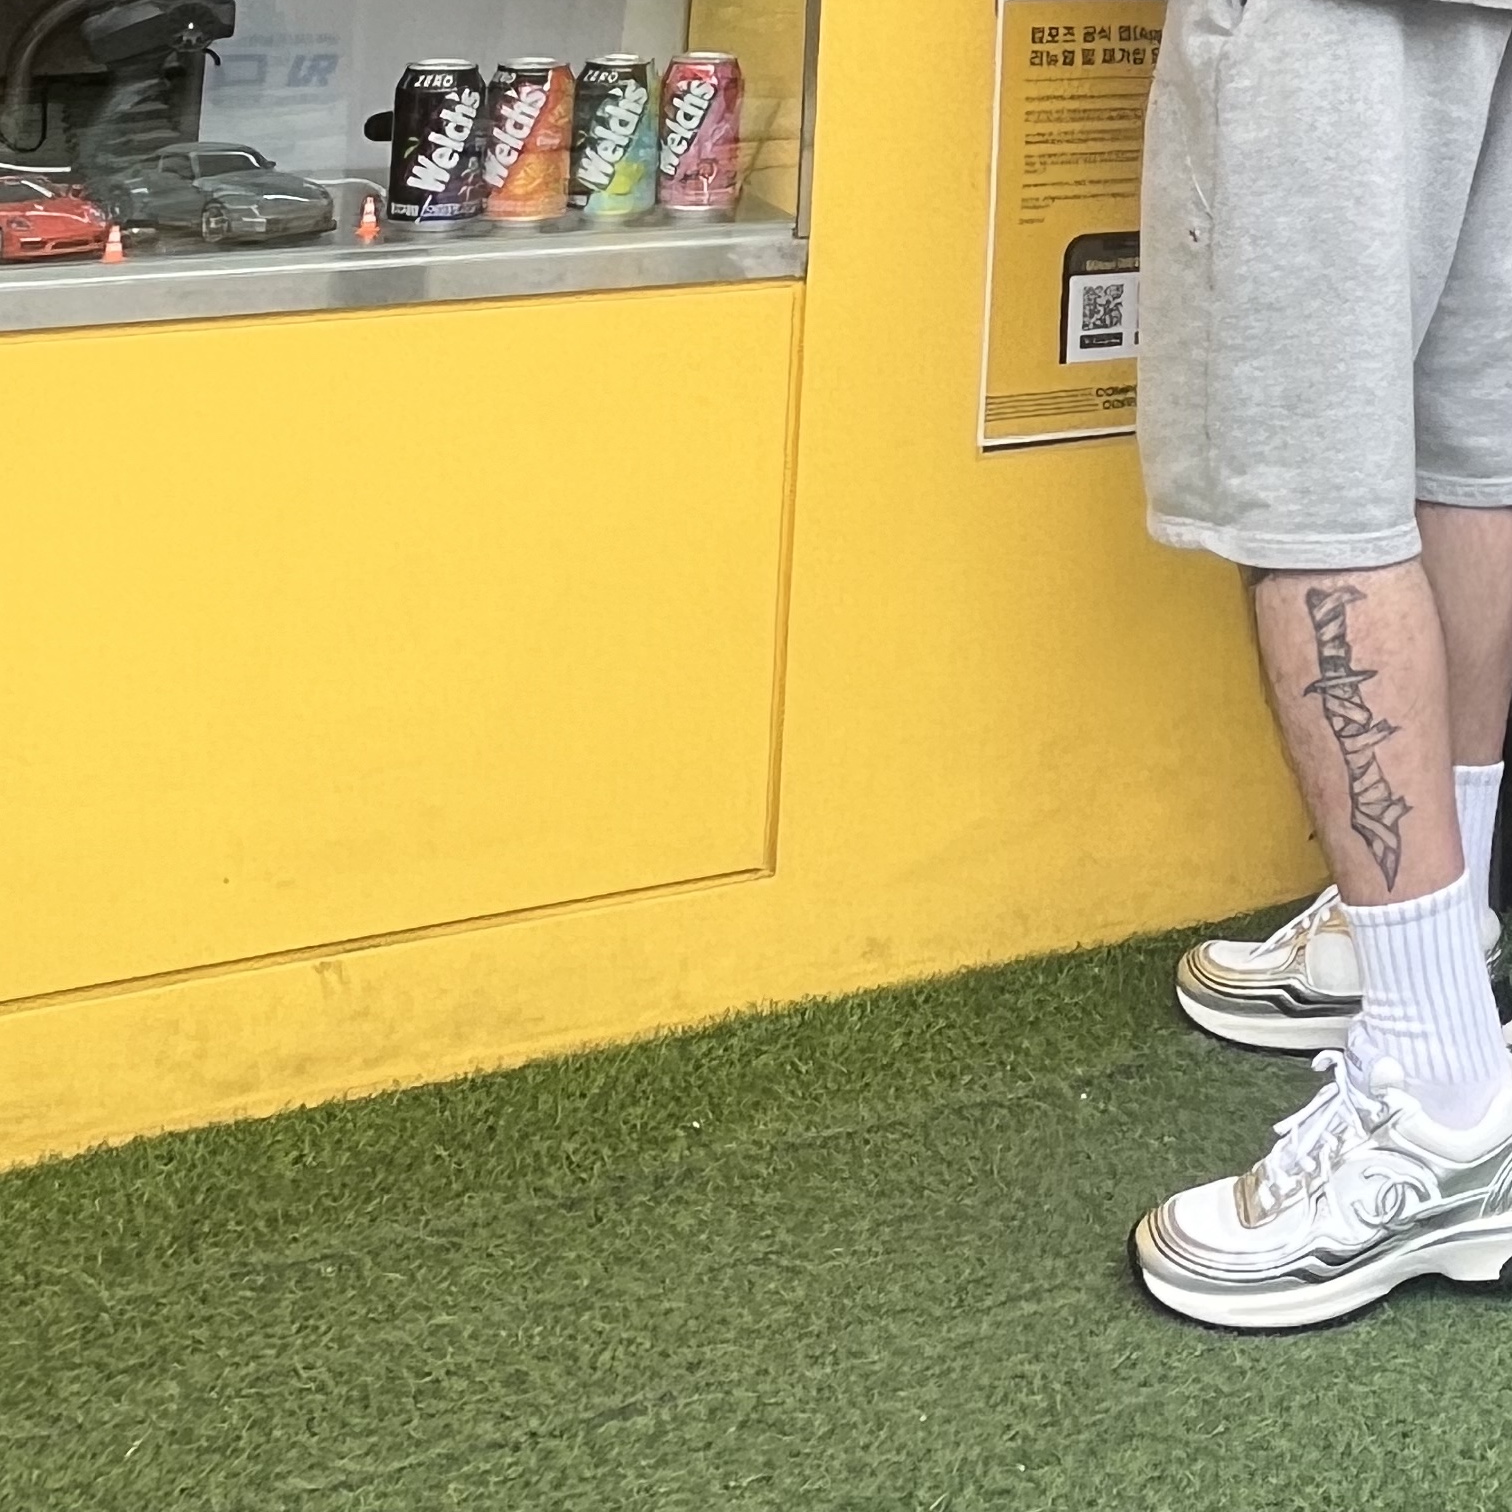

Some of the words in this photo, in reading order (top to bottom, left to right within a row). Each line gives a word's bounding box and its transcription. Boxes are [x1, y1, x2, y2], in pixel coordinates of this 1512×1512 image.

[414, 73, 454, 88] ZERO
[583, 68, 619, 84] ZERO
[406, 87, 481, 193] Welch's
